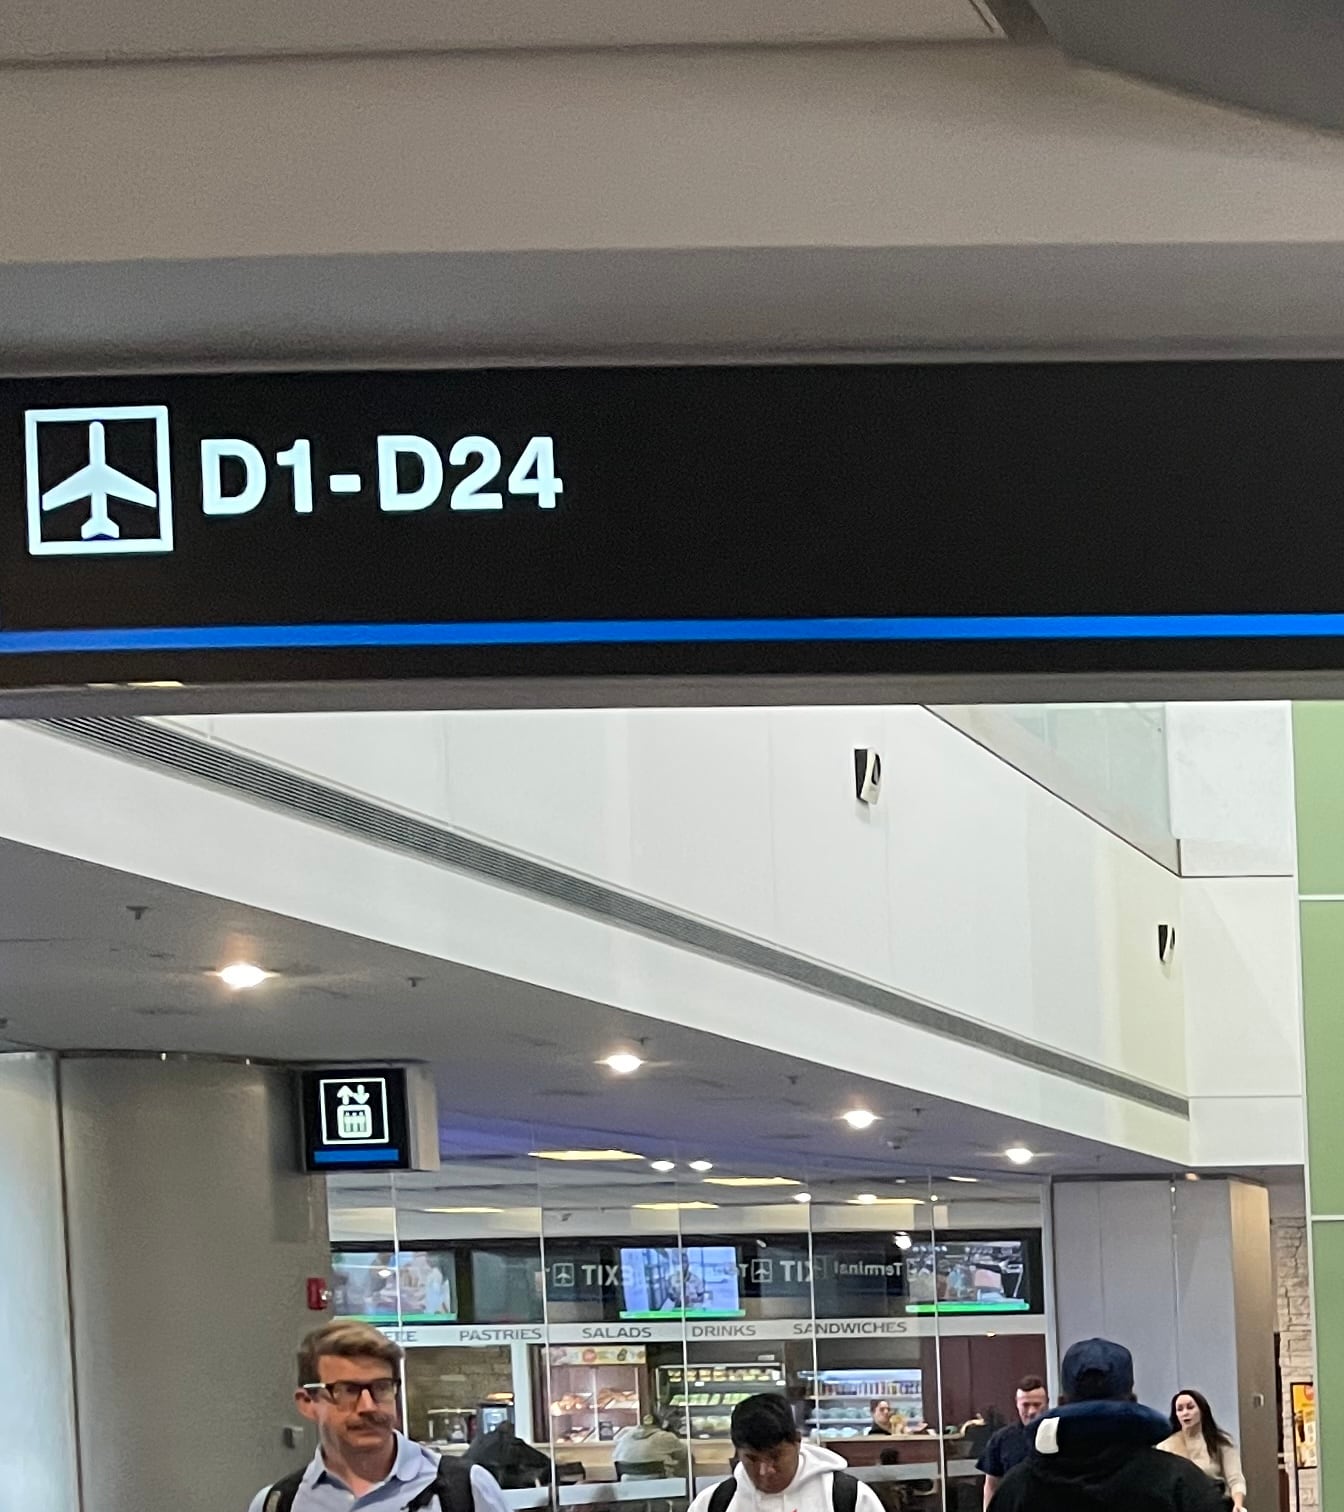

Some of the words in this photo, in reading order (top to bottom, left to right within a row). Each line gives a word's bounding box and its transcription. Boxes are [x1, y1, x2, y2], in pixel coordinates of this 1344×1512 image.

[200, 435, 563, 516] D1-D24
[459, 1327, 542, 1342] PASTRIES
[582, 1326, 652, 1339] SALADS
[692, 1325, 756, 1338] DRINKS
[793, 1321, 908, 1335] SANDWICHES
